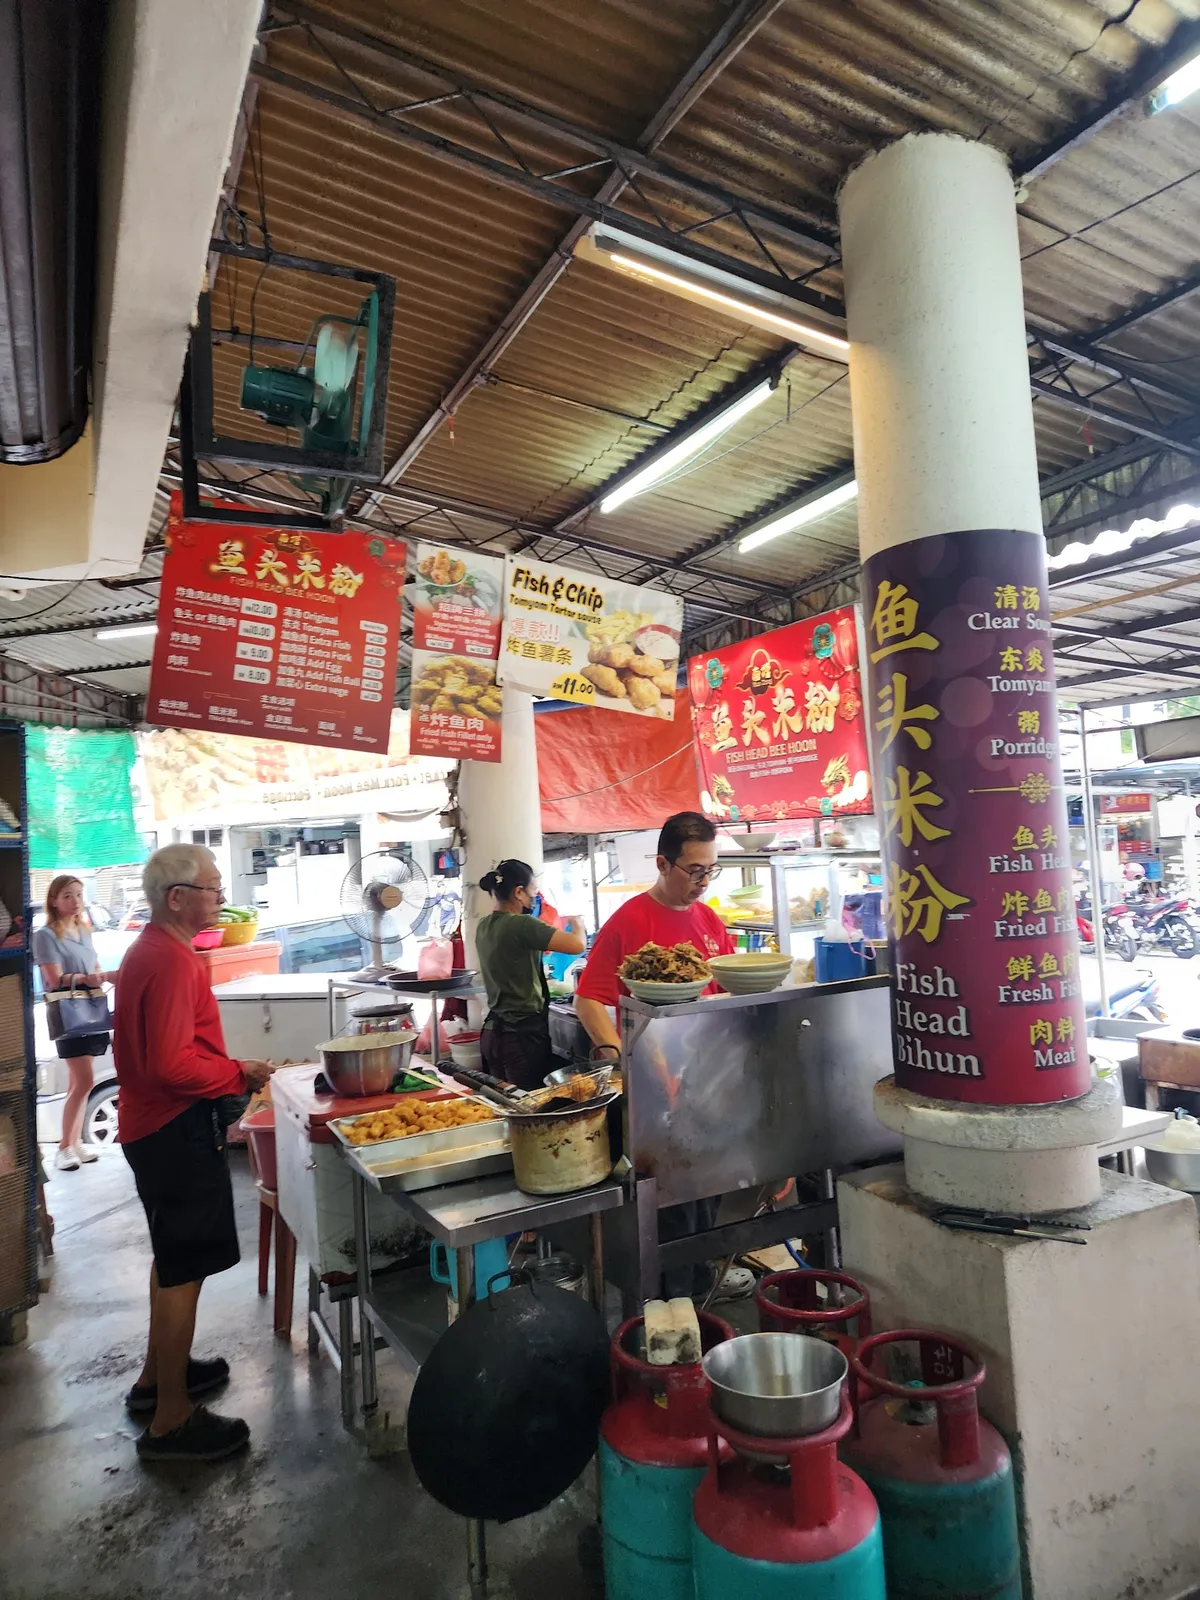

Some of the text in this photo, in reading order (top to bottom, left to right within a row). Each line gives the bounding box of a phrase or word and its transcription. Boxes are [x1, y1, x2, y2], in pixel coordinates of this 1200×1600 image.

[209, 540, 363, 598] 鱼头米粉
[230, 576, 254, 588] FISH
[256, 582, 284, 594] HEAD
[285, 587, 304, 599] BEE
[512, 568, 603, 612] Fish & Chip
[994, 584, 1041, 611] 清汤
[194, 613, 206, 621] or
[549, 602, 576, 620] Tartar
[967, 612, 1020, 631] Clear
[308, 647, 331, 659] Extra
[309, 635, 332, 647] Extra
[332, 640, 352, 650] Fish
[506, 636, 573, 667] 炸鱼薯条
[306, 659, 326, 669] Add
[326, 661, 343, 674] Egg
[999, 646, 1046, 673] 东炎
[304, 681, 328, 693] Extra
[305, 670, 324, 681] Add
[324, 673, 343, 684] Fish
[343, 676, 361, 686] Ball
[430, 713, 484, 731] 炸鱼肉
[711, 680, 840, 754] 鱼头米粉
[1017, 710, 1040, 735] 粥
[420, 727, 440, 737] Fried
[440, 729, 456, 738] Fish
[476, 734, 493, 743] only
[726, 738, 818, 764] FISH HEAD BEE HOON
[868, 579, 970, 943] 鱼头米粉
[1012, 825, 1059, 851] 鱼头
[989, 854, 1033, 874] Fish
[994, 920, 1047, 938] Fried
[895, 963, 959, 998] Fish
[998, 983, 1053, 1003] Fresh
[895, 997, 971, 1037] Head
[1029, 1016, 1076, 1046] 肉料
[1034, 1048, 1076, 1069] Meat
